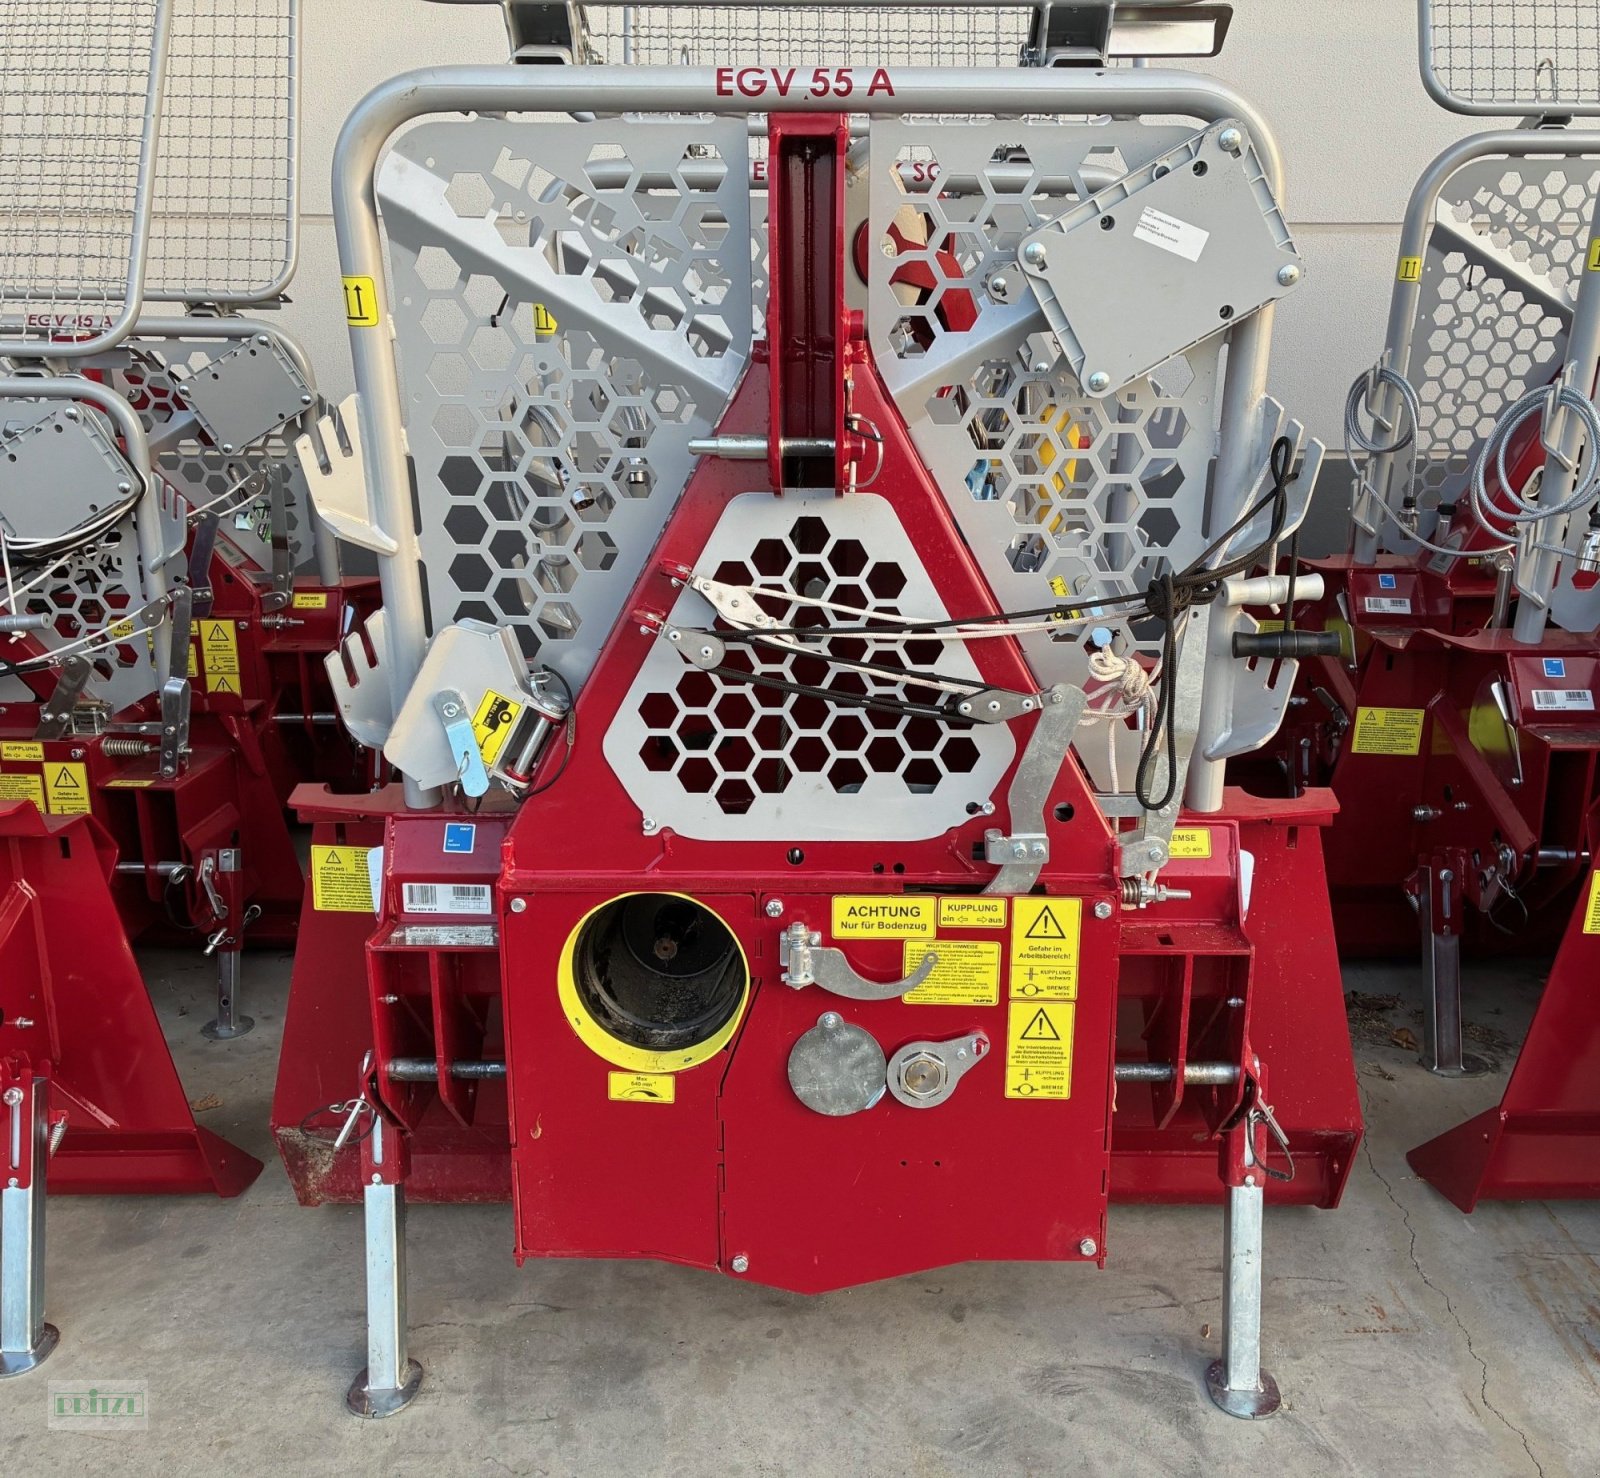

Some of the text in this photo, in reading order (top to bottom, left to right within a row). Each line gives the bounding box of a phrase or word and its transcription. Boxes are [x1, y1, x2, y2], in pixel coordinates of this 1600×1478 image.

[716, 68, 895, 97] EGV 55 A
[28, 314, 68, 327] EGV
[847, 906, 921, 918] ACHTUNG
[947, 904, 998, 912] KUPPLUNG
[841, 921, 927, 931] Nur für Bodenzug
[1018, 952, 1071, 960] Arbeitsbereich!
